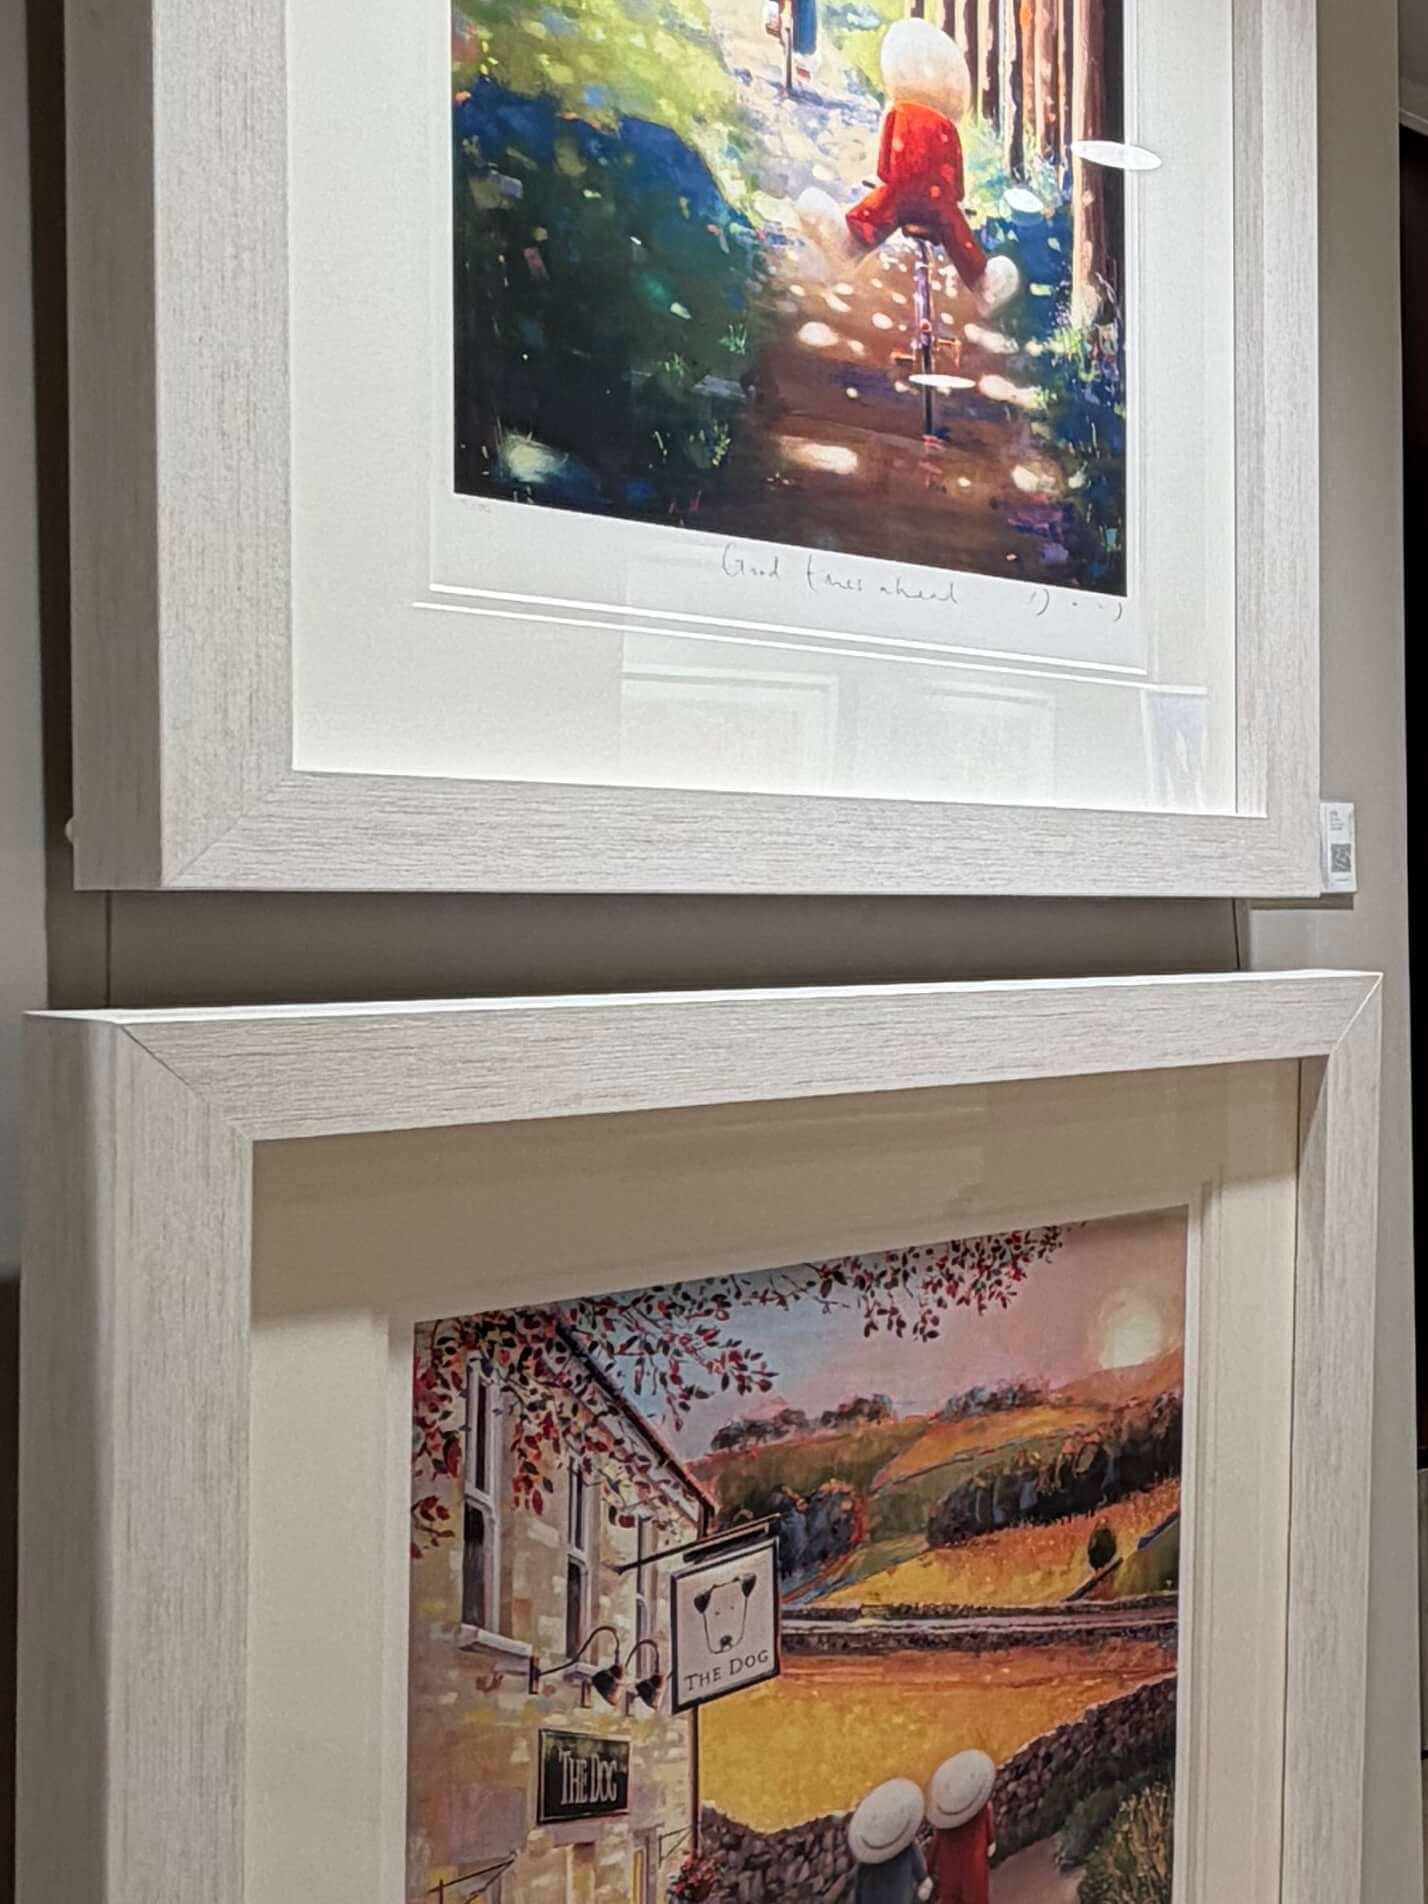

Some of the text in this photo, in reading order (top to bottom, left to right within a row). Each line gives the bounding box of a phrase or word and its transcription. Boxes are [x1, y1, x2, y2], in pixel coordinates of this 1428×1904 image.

[684, 1649, 769, 1692] THE DOG
[559, 1748, 618, 1805] THE DOG
